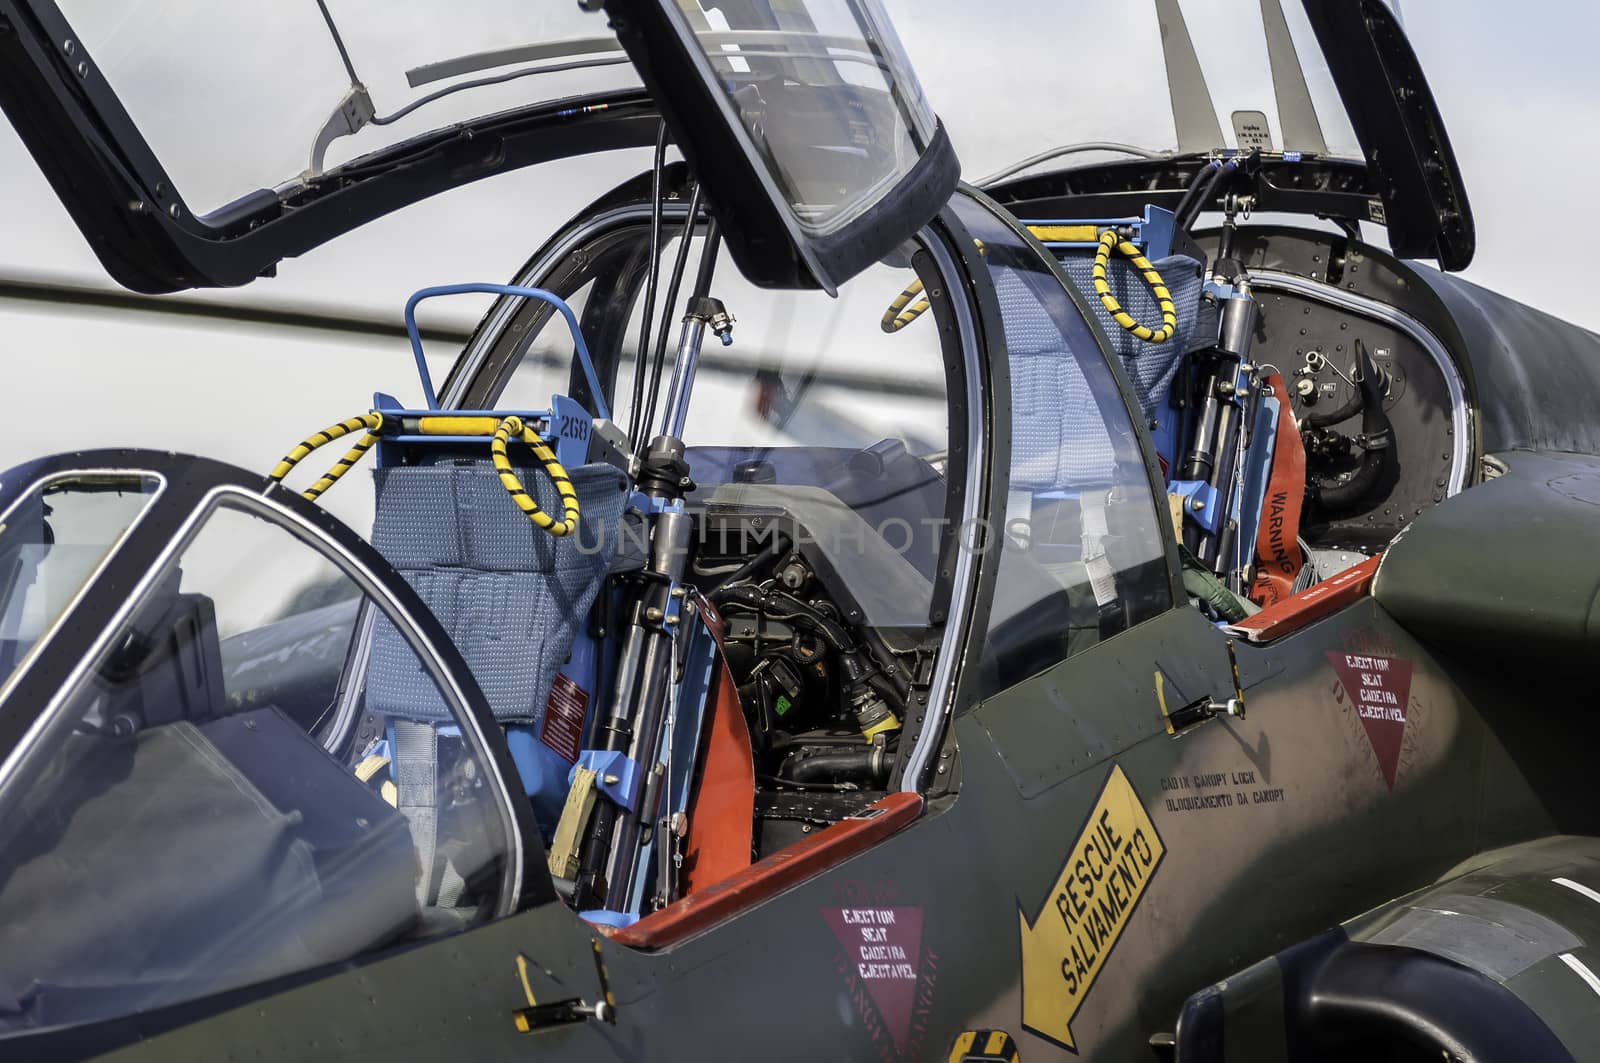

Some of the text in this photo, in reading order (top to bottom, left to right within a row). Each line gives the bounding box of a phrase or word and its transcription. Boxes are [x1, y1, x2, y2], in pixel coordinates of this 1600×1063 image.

[560, 415, 588, 441] 268
[1268, 491, 1295, 575] WARNING
[1345, 655, 1390, 671] EJECTION
[1361, 673, 1383, 687] SEAT
[1360, 688, 1398, 705] CADEIRA
[1358, 704, 1406, 722] EJECTAVEL
[1194, 773, 1228, 788] CANOPY
[1232, 771, 1256, 785] LOCK
[1237, 792, 1248, 805] DA
[1055, 808, 1122, 935] RESCUE
[842, 909, 896, 925] EJECTION
[1061, 827, 1153, 996] SALVAMENTO
[861, 928, 888, 942] SEAT
[859, 946, 906, 961] CADEIRA
[858, 963, 917, 979] EJECTAVEL
